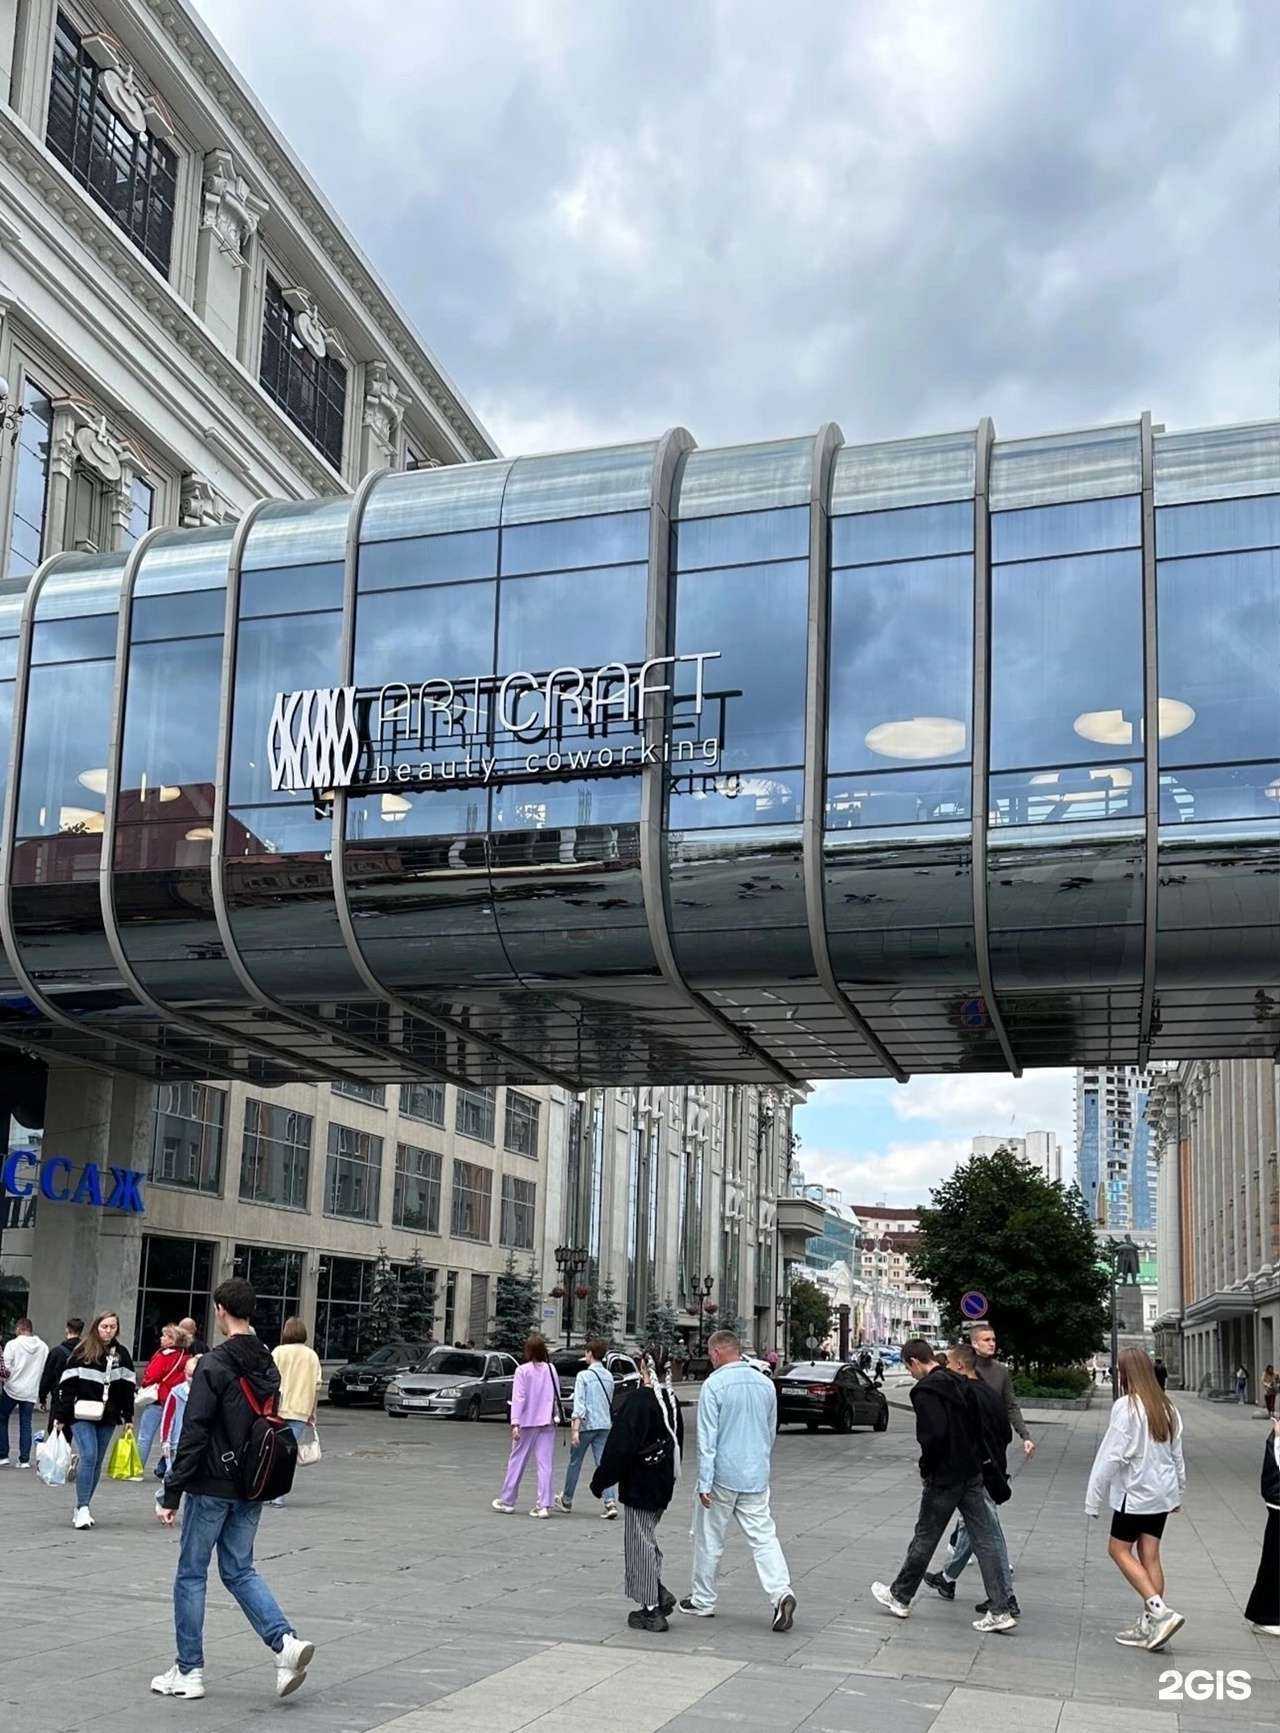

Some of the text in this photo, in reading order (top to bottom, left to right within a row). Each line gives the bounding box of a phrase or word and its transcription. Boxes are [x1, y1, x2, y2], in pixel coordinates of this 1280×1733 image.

[378, 651, 722, 741] ARTCRAFT
[375, 734, 719, 784] beauty coworking
